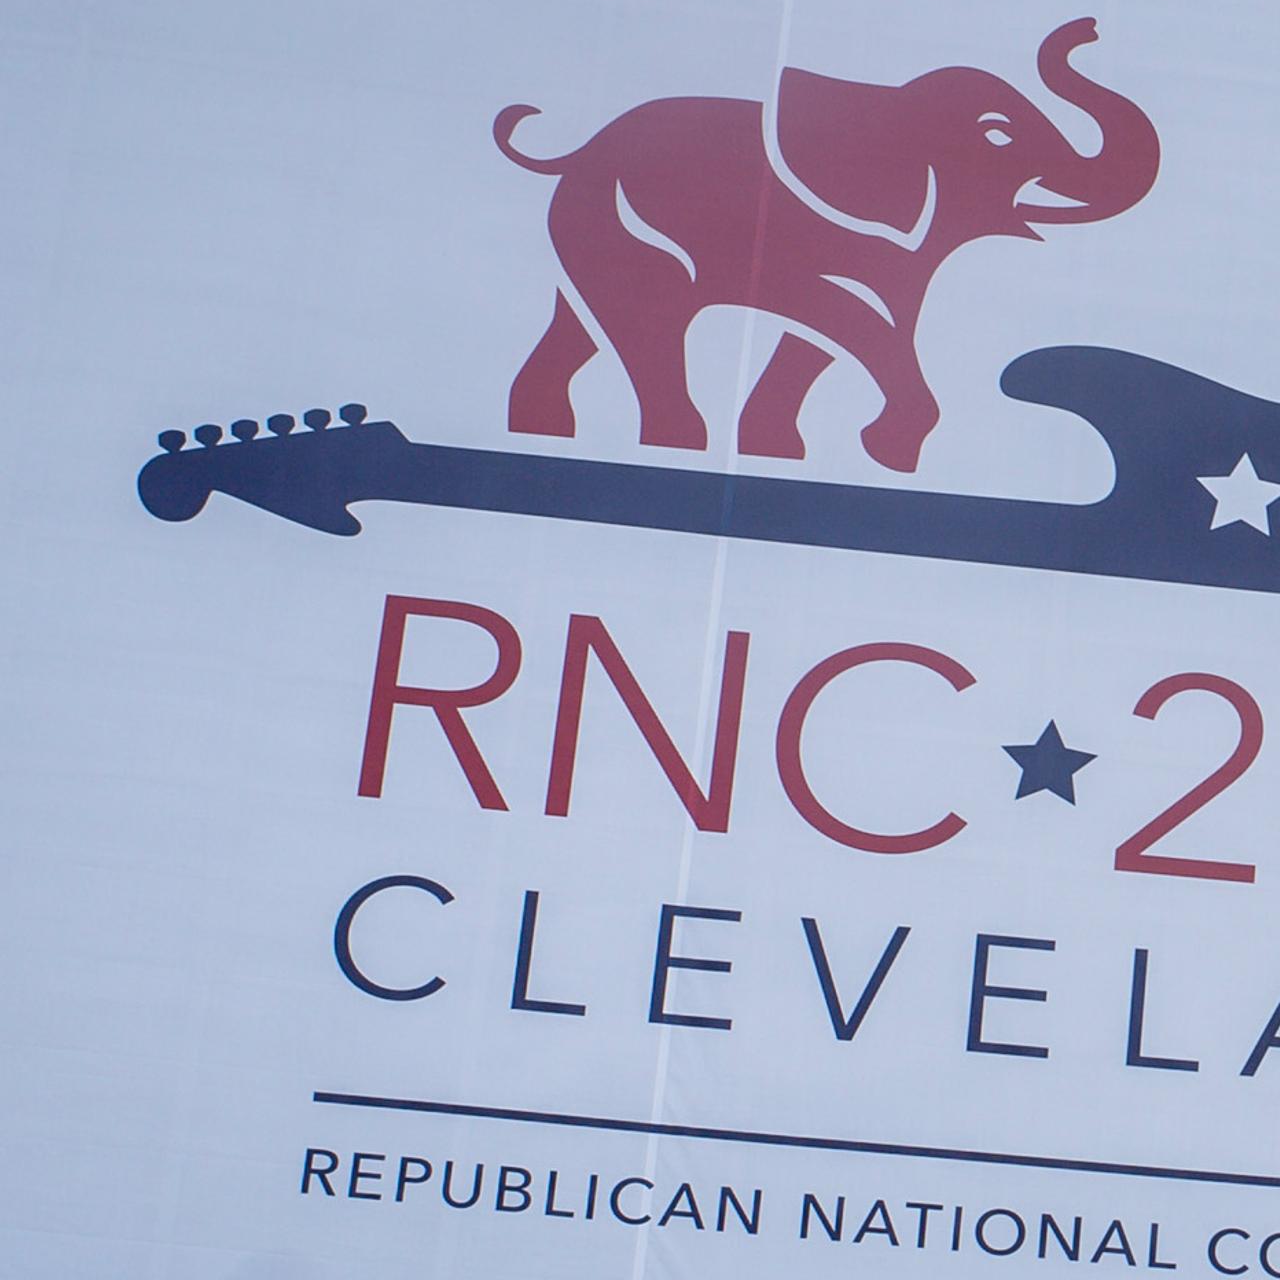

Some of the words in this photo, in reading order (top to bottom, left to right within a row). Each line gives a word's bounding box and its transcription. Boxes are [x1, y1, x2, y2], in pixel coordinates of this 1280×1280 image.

[357, 594, 976, 855] RNC
[300, 1147, 763, 1236] REPUBLICAN
[798, 1192, 1178, 1271] NATIONAL
